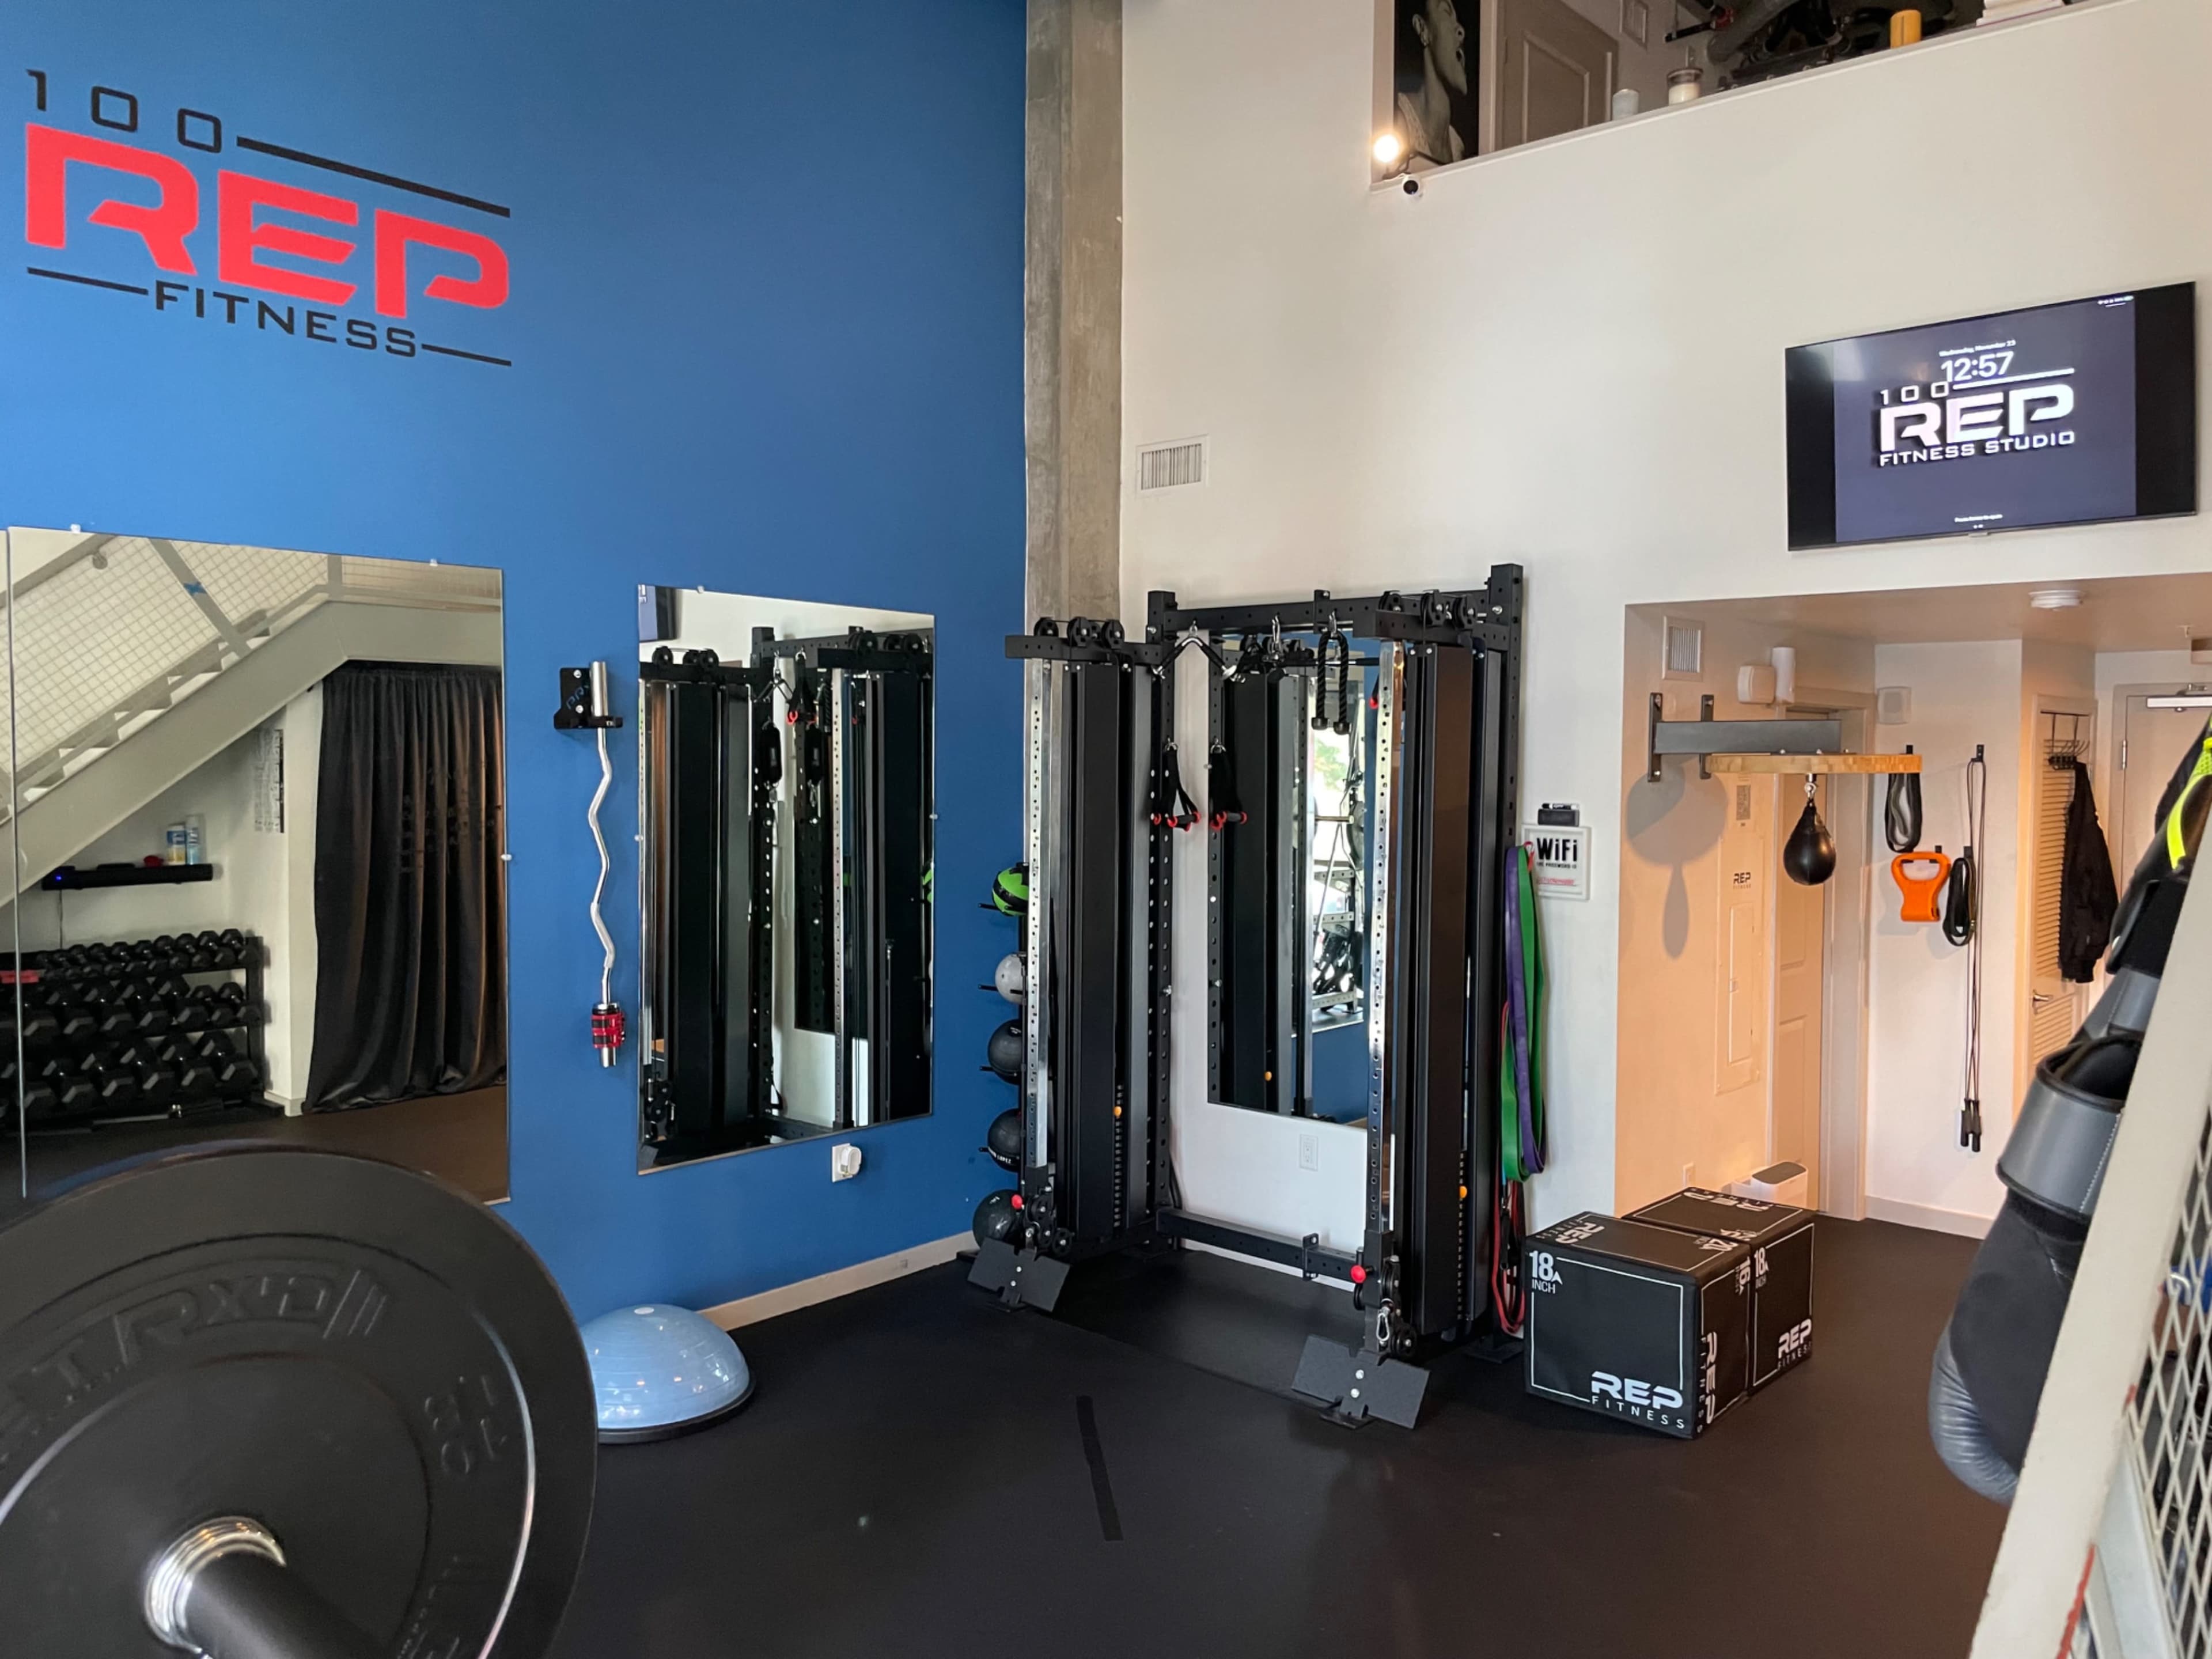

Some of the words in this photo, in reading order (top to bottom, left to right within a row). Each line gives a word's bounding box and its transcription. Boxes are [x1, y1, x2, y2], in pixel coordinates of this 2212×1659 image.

[26, 69, 222, 153] 100
[26, 123, 510, 319] REP
[155, 280, 416, 358] FITNESS
[1941, 350, 2014, 382] 12:57
[1880, 381, 1950, 406] 100
[1880, 384, 2074, 453] REP
[1880, 443, 1975, 467] FITNESS
[1984, 431, 2075, 454] STUDIO
[1536, 838, 1578, 862] WiFi
[1733, 872, 1751, 884] REP
[1555, 1222, 1605, 1244] REP
[1529, 1250, 1554, 1281] 18
[1754, 1247, 1766, 1277] 18
[1532, 1278, 1556, 1294] INCH
[1778, 1318, 1812, 1359] REP
[1591, 1370, 1683, 1410] REP
[1705, 1331, 1718, 1425] REP
[1592, 1396, 1685, 1429] FITNESS
